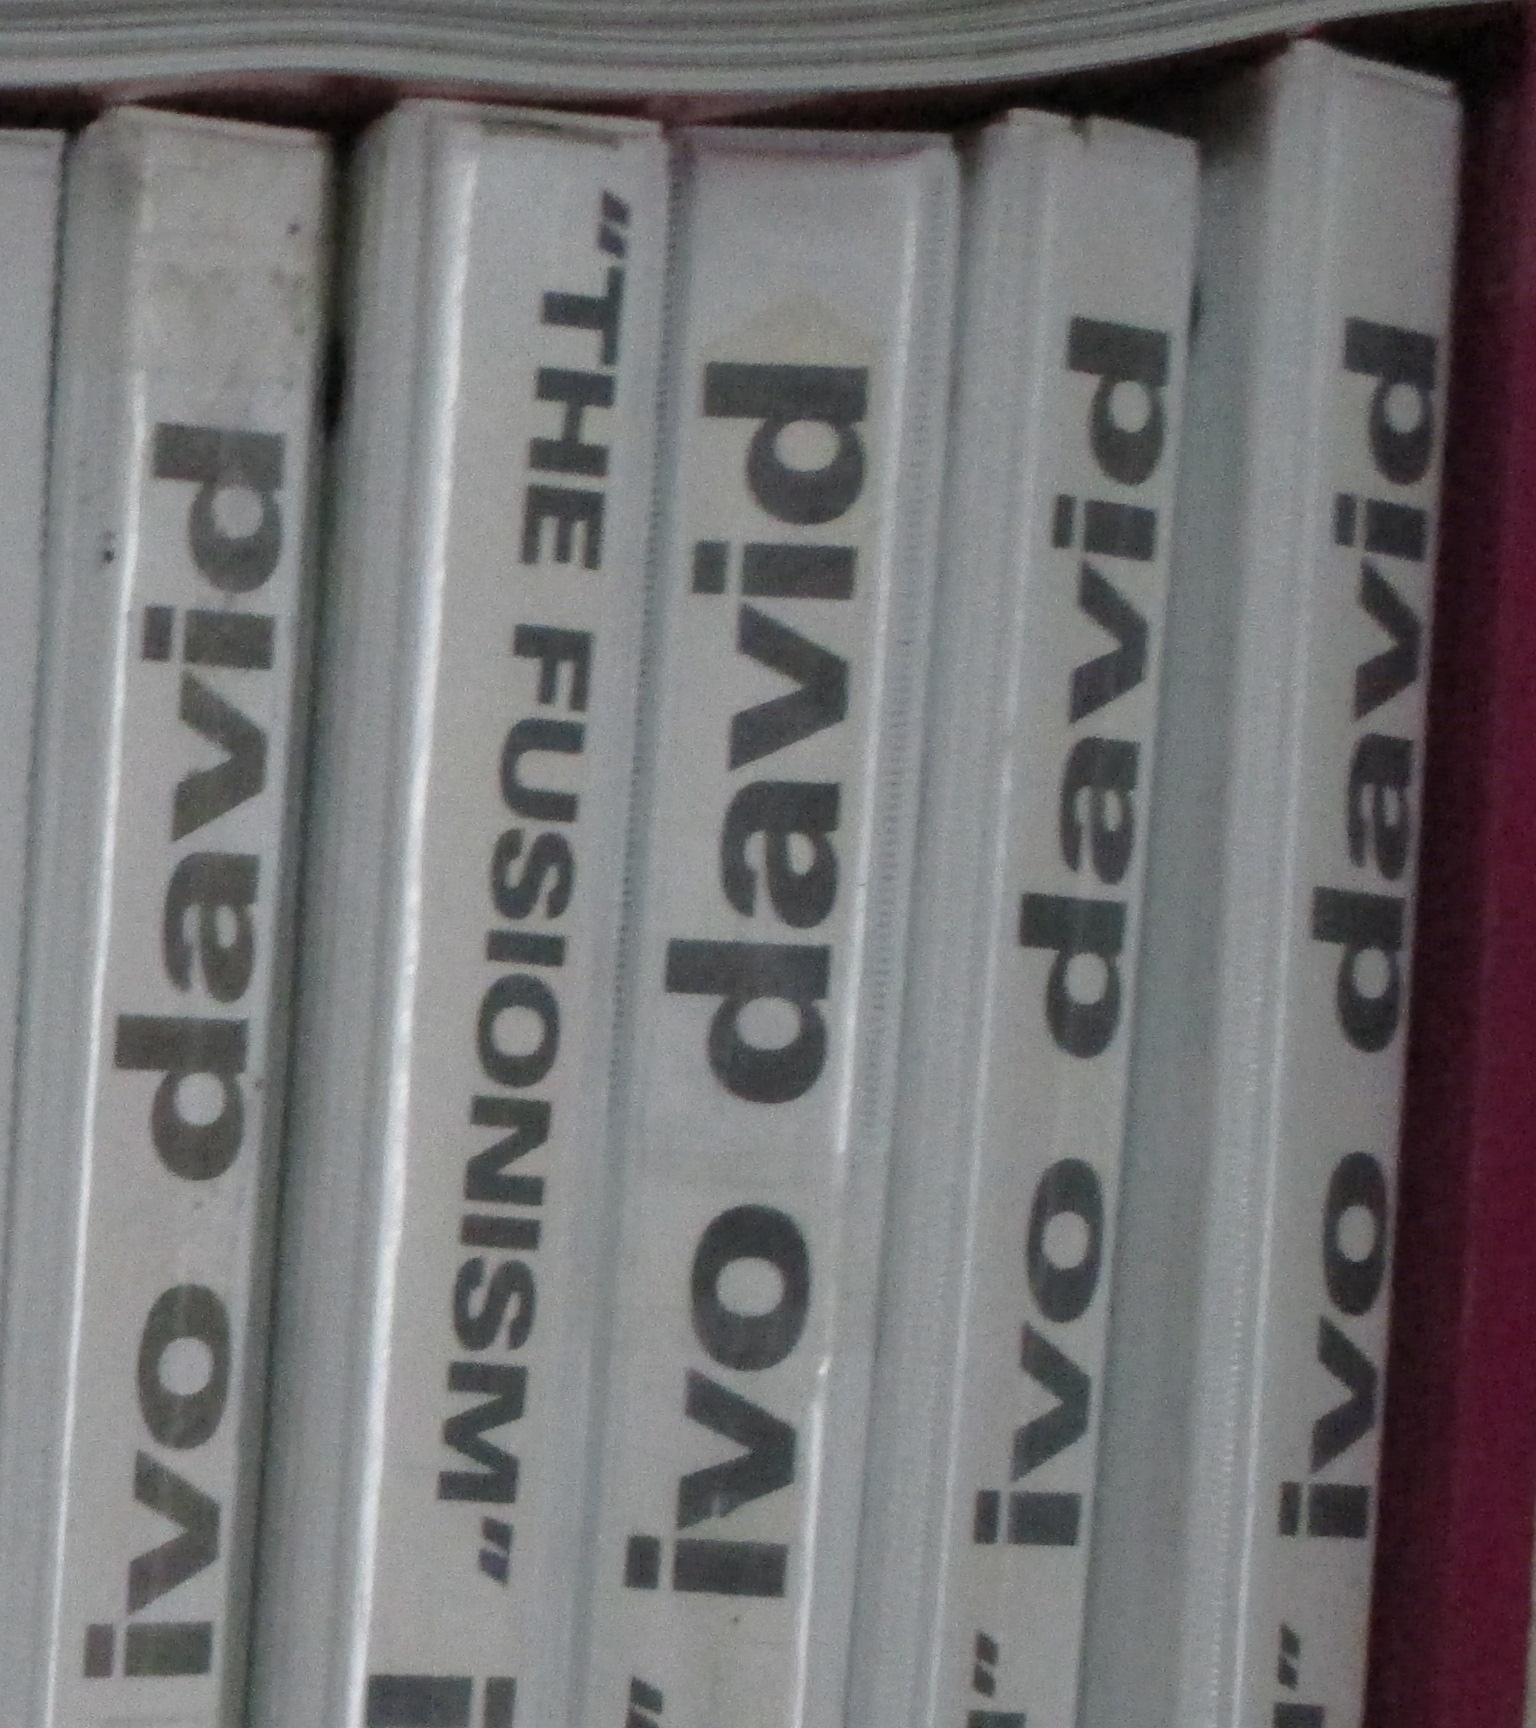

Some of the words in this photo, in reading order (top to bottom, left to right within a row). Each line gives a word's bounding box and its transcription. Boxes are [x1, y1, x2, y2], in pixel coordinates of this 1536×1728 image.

[520, 190, 631, 571] "THE
[113, 422, 286, 1182] david
[658, 360, 870, 1105] david
[1018, 315, 1171, 1059] david
[1312, 316, 1440, 1054] david
[437, 623, 594, 1586] FUSIONISM"
[972, 1158, 1105, 1547] ivo
[1278, 1151, 1389, 1540] ivo
[83, 1283, 232, 1679] ivo
[623, 1203, 812, 1599] ivo
